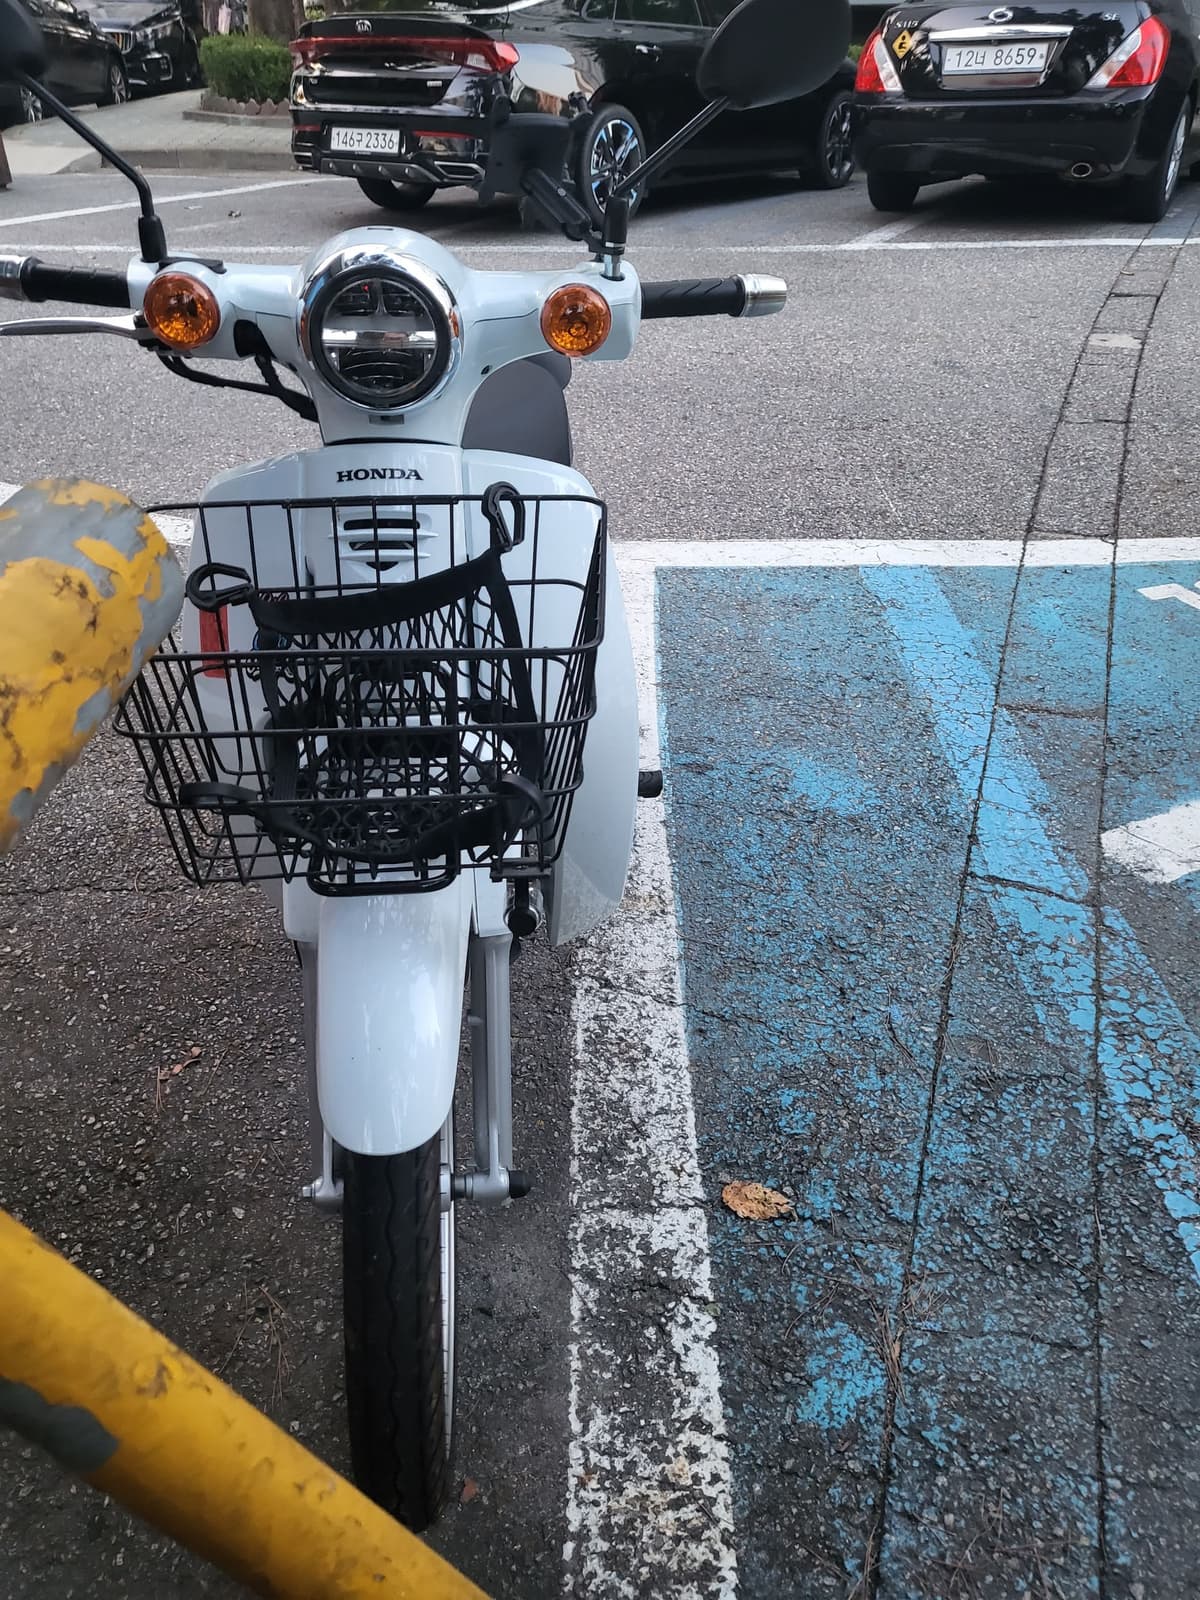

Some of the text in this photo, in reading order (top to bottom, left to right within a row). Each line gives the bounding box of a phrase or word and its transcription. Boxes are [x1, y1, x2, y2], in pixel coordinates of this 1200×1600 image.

[955, 47, 1037, 68] 12너 8659
[336, 130, 395, 150] 146구 2336
[336, 467, 424, 483] HONDA
